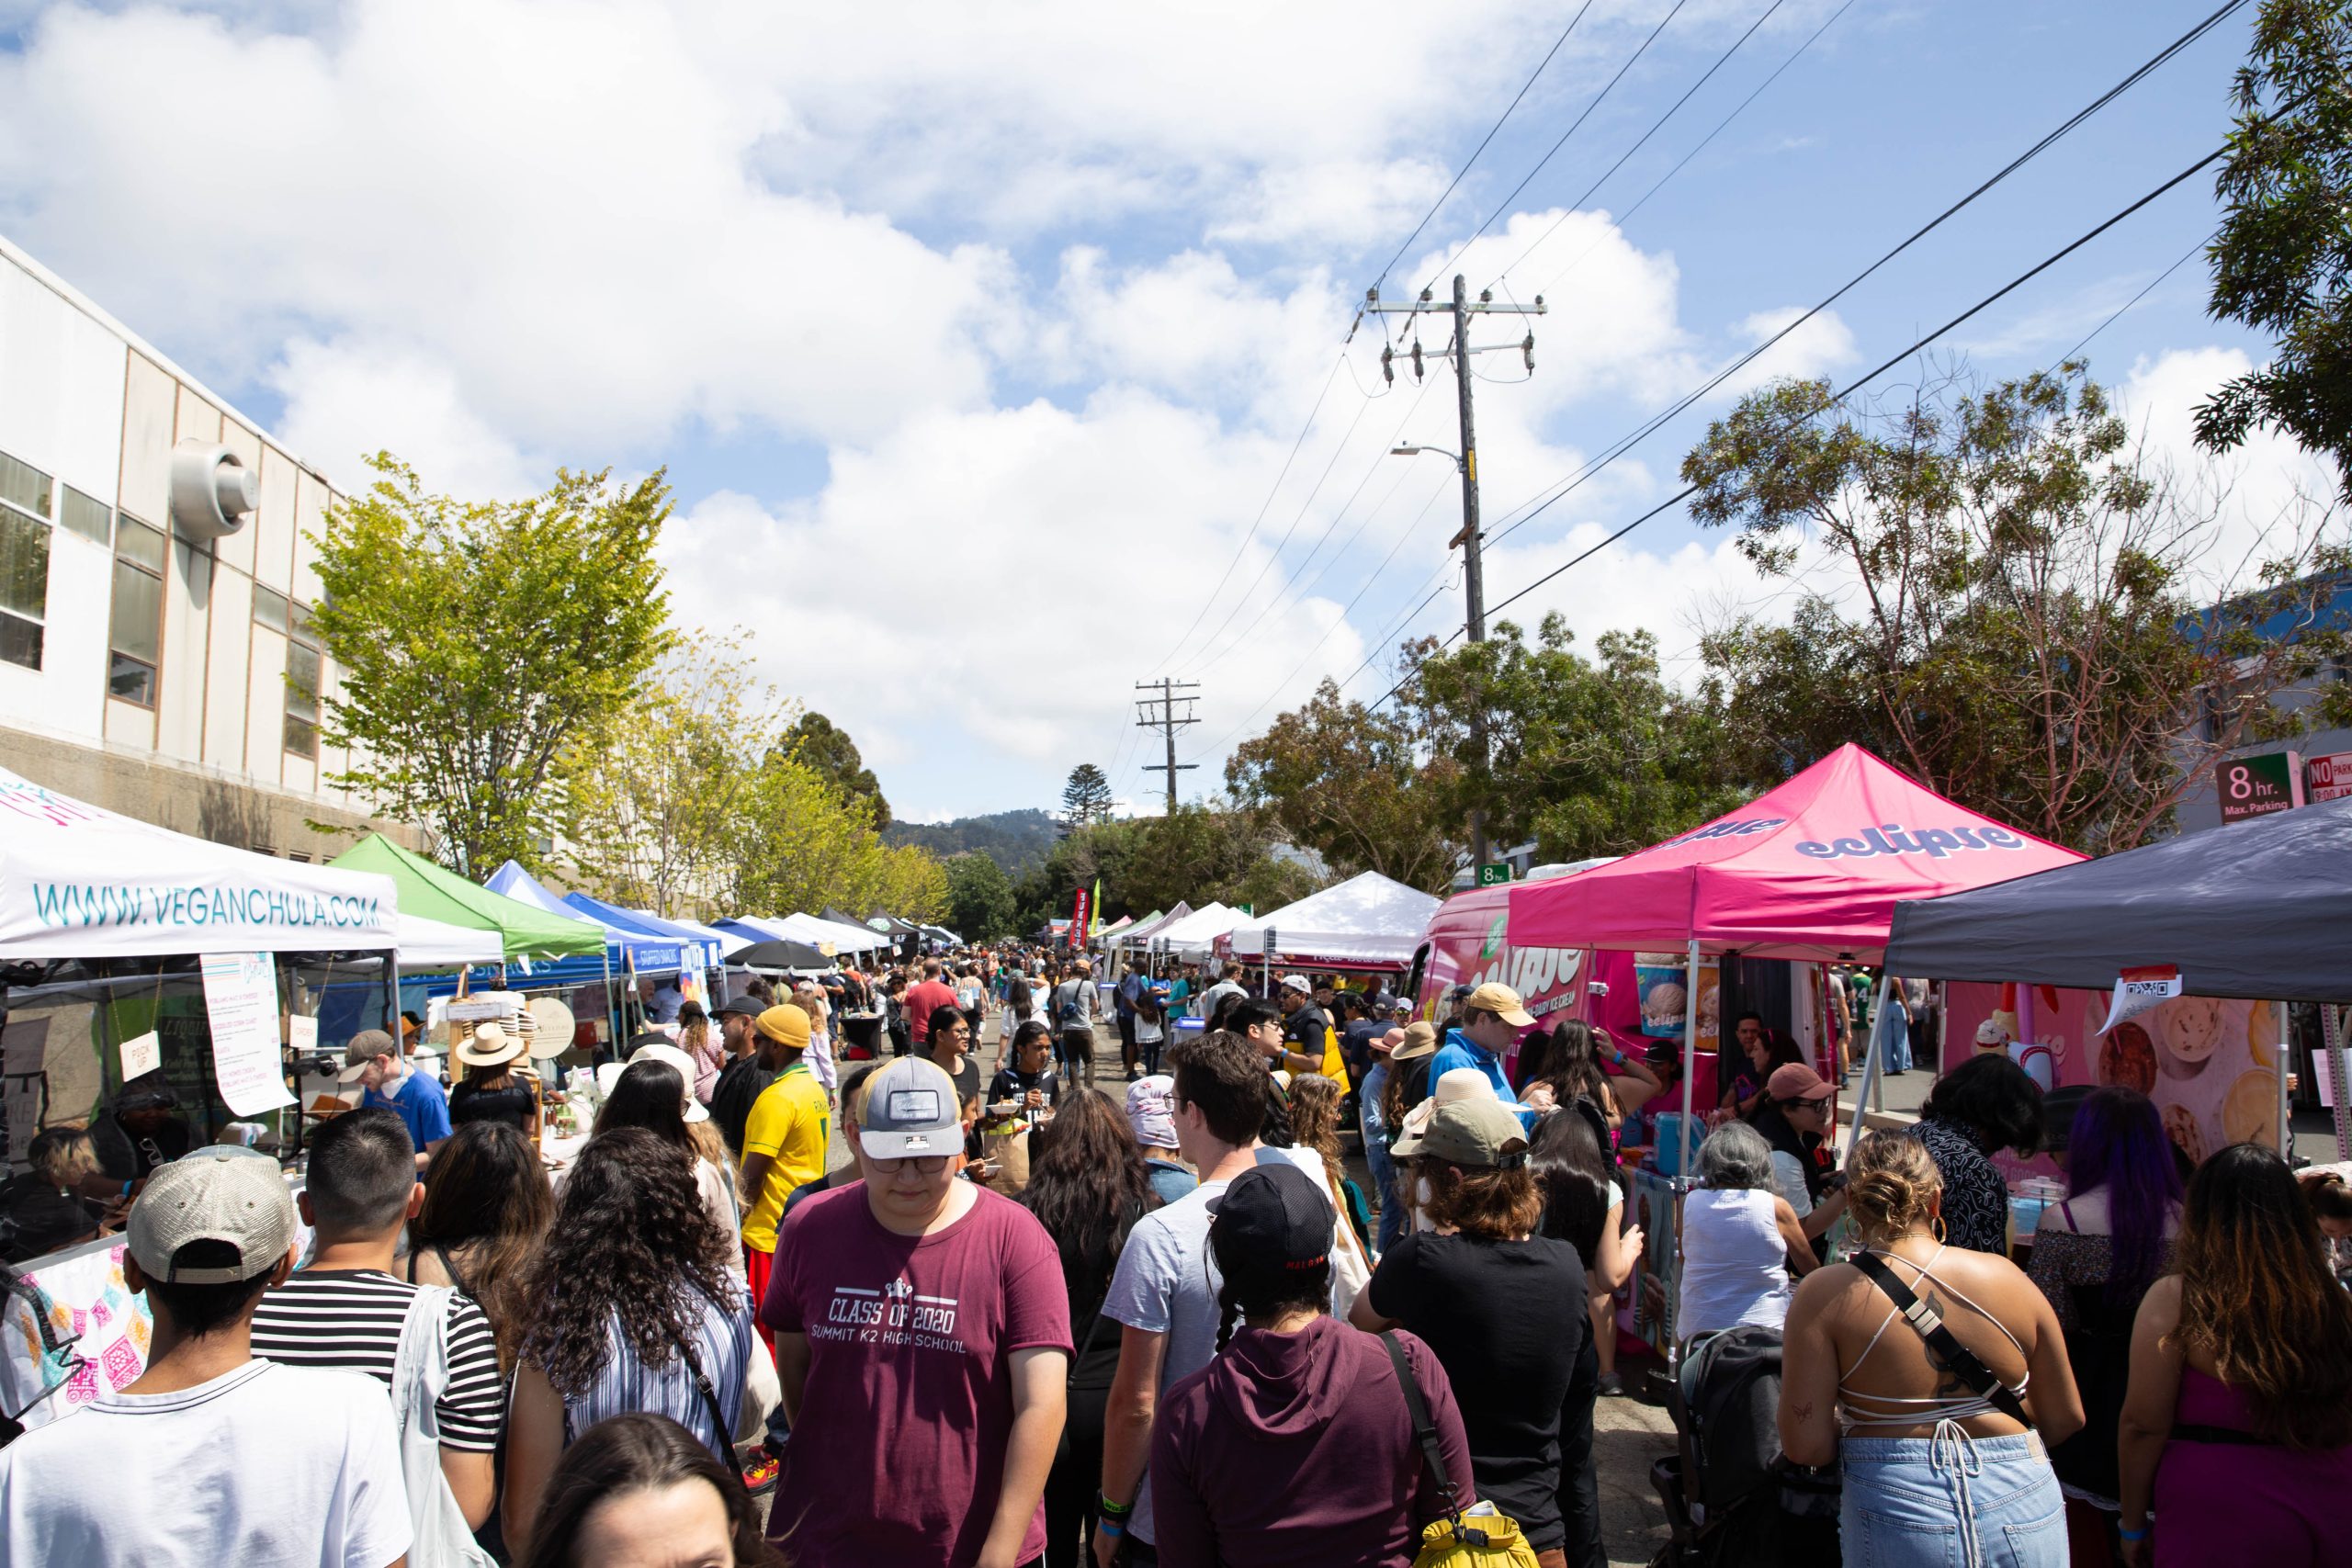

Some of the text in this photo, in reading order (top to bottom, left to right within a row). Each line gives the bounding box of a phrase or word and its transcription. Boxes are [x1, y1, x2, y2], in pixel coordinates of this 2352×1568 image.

[2229, 766, 2278, 799] 8 hr.
[2311, 761, 2333, 784] NO
[2225, 801, 2289, 816] Max. Parking
[1794, 824, 2026, 858] eclipse
[1484, 867, 1494, 882] 8
[33, 883, 380, 928] WWW.VEGANCHULA.COM
[132, 1045, 151, 1059] PICK
[137, 1056, 148, 1067] UP
[829, 1298, 956, 1334] CLASS OF 2020
[811, 1325, 967, 1354] SUMMIT K2 HIGH SCHOOL
